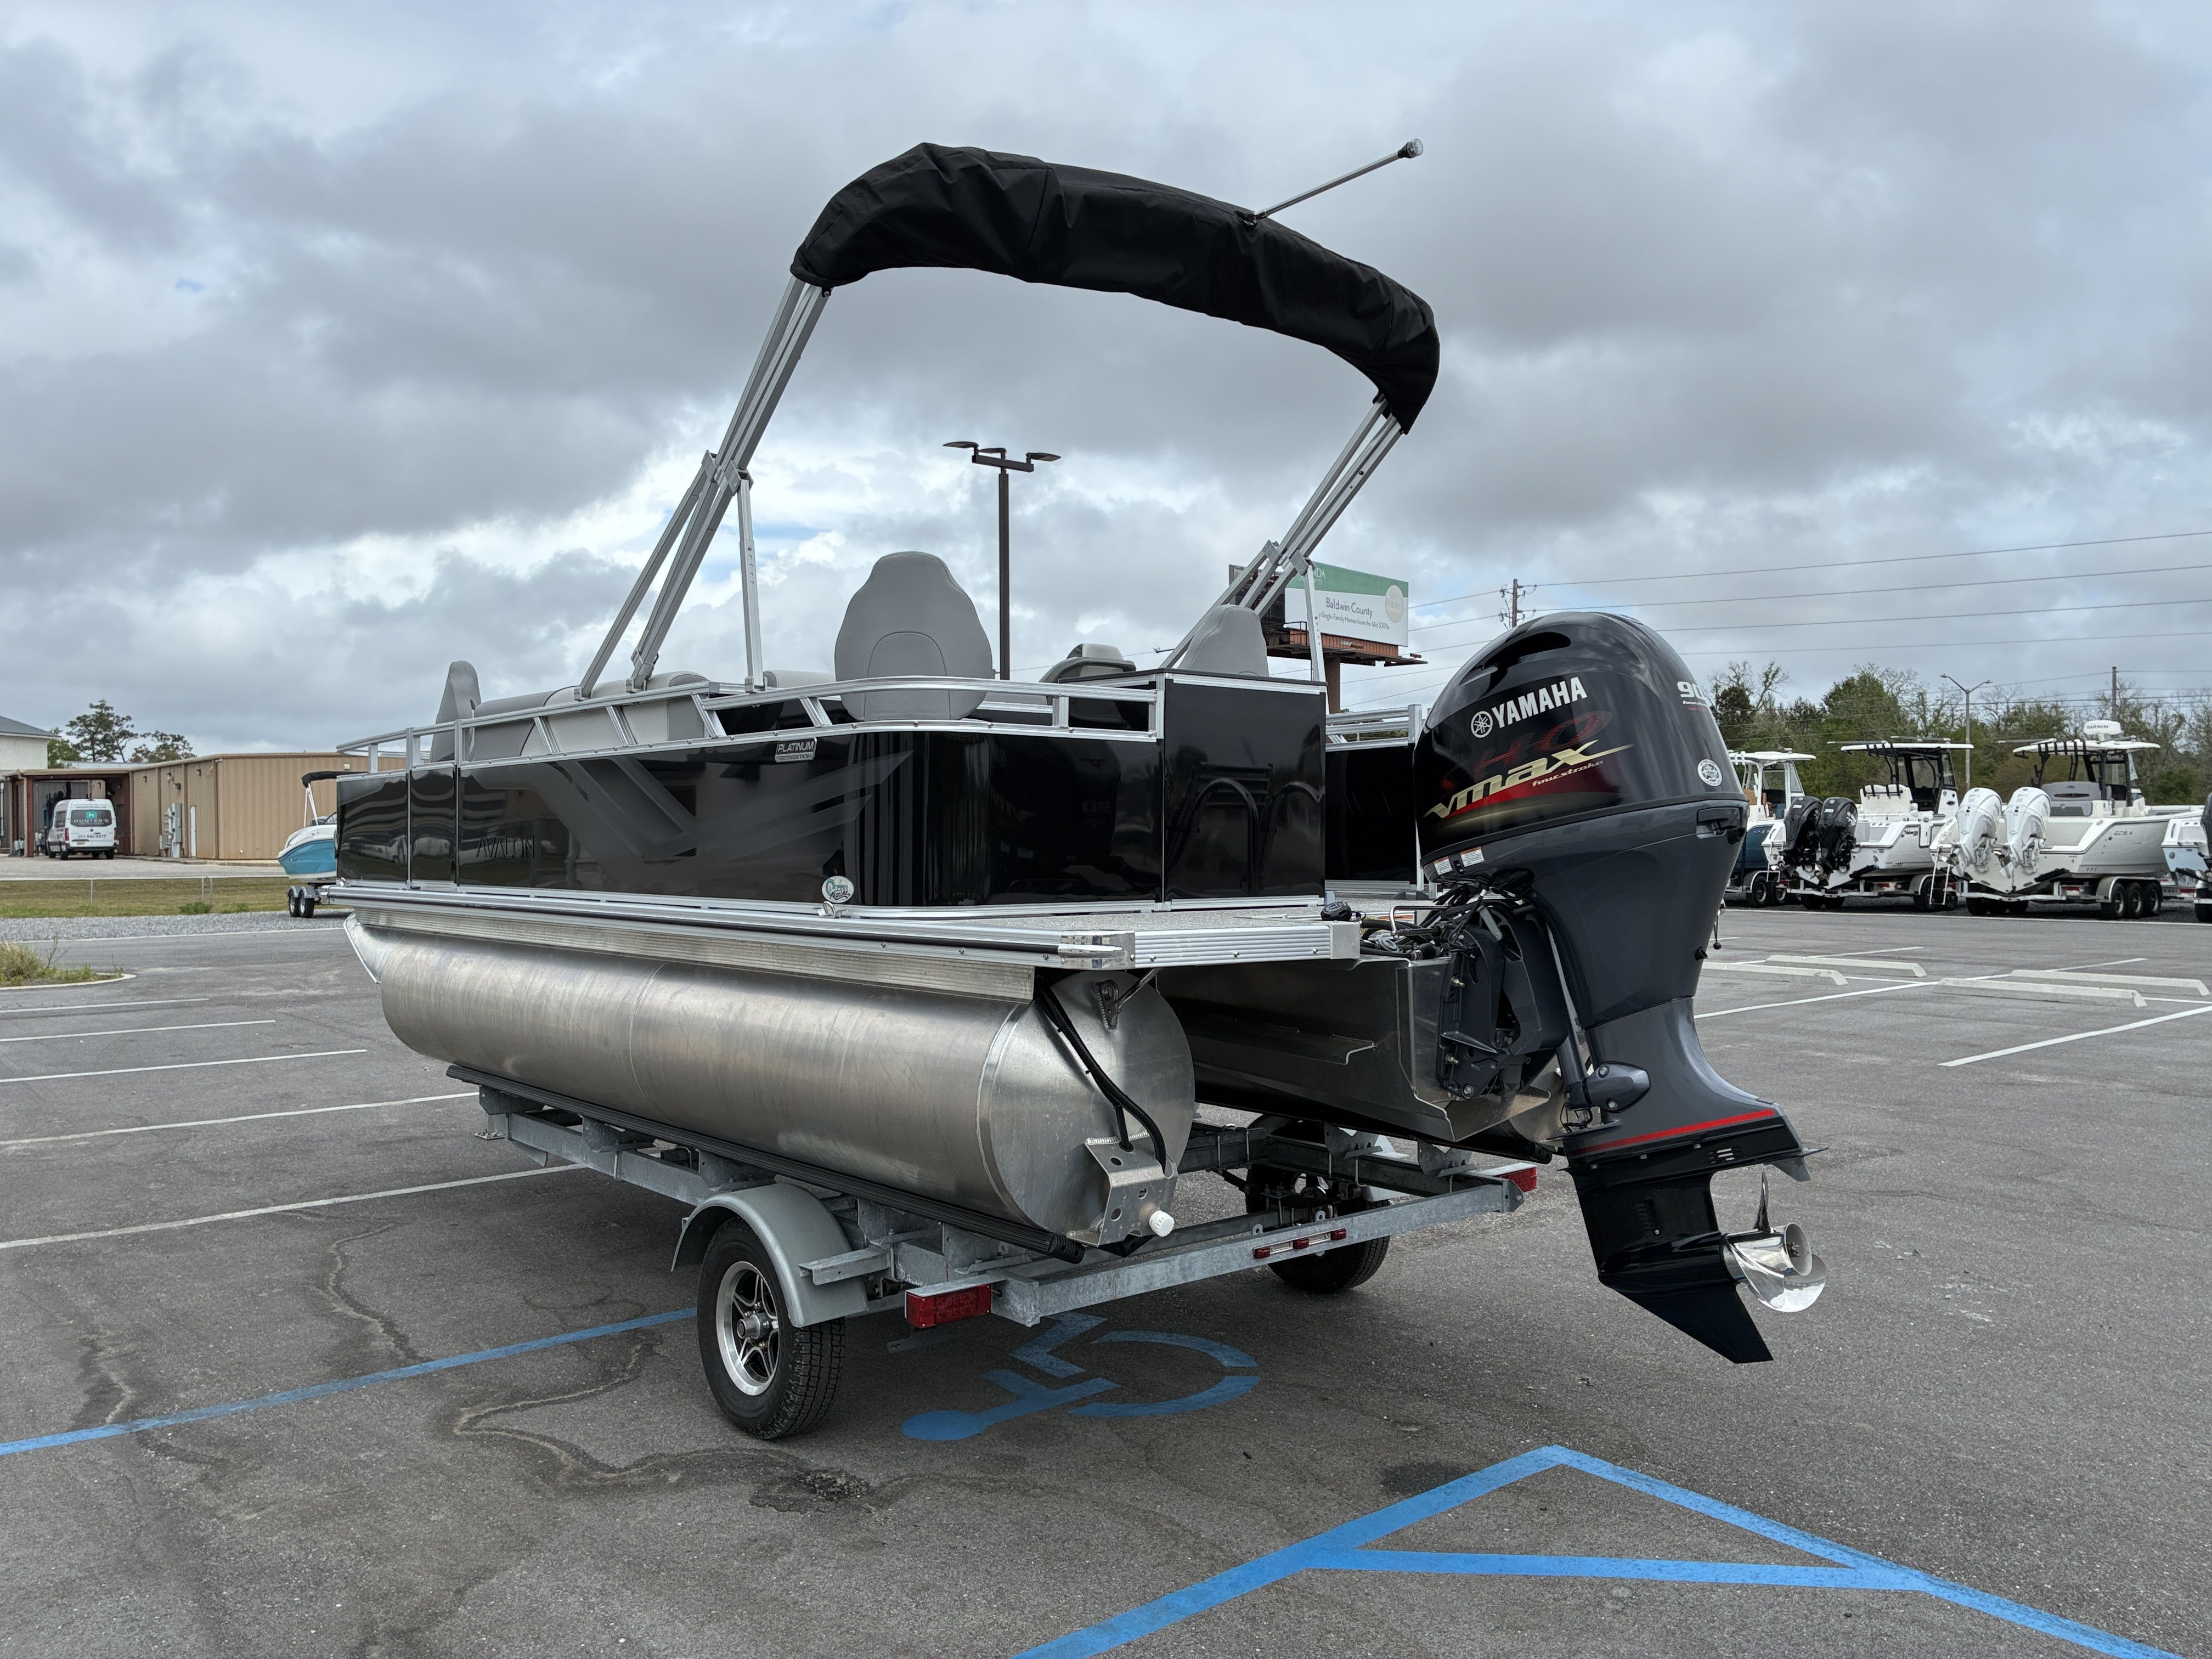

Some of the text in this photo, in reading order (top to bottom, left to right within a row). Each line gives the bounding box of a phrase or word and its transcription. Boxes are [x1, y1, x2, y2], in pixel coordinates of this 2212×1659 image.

[1326, 597, 1350, 612] Baldwin
[1351, 602, 1373, 619] County
[1677, 681, 1706, 699] 90
[1492, 676, 1588, 729] YAMAHA
[778, 741, 814, 753] PLATINUM
[1532, 760, 1603, 787] fourstroke
[476, 837, 535, 859] AVALON
